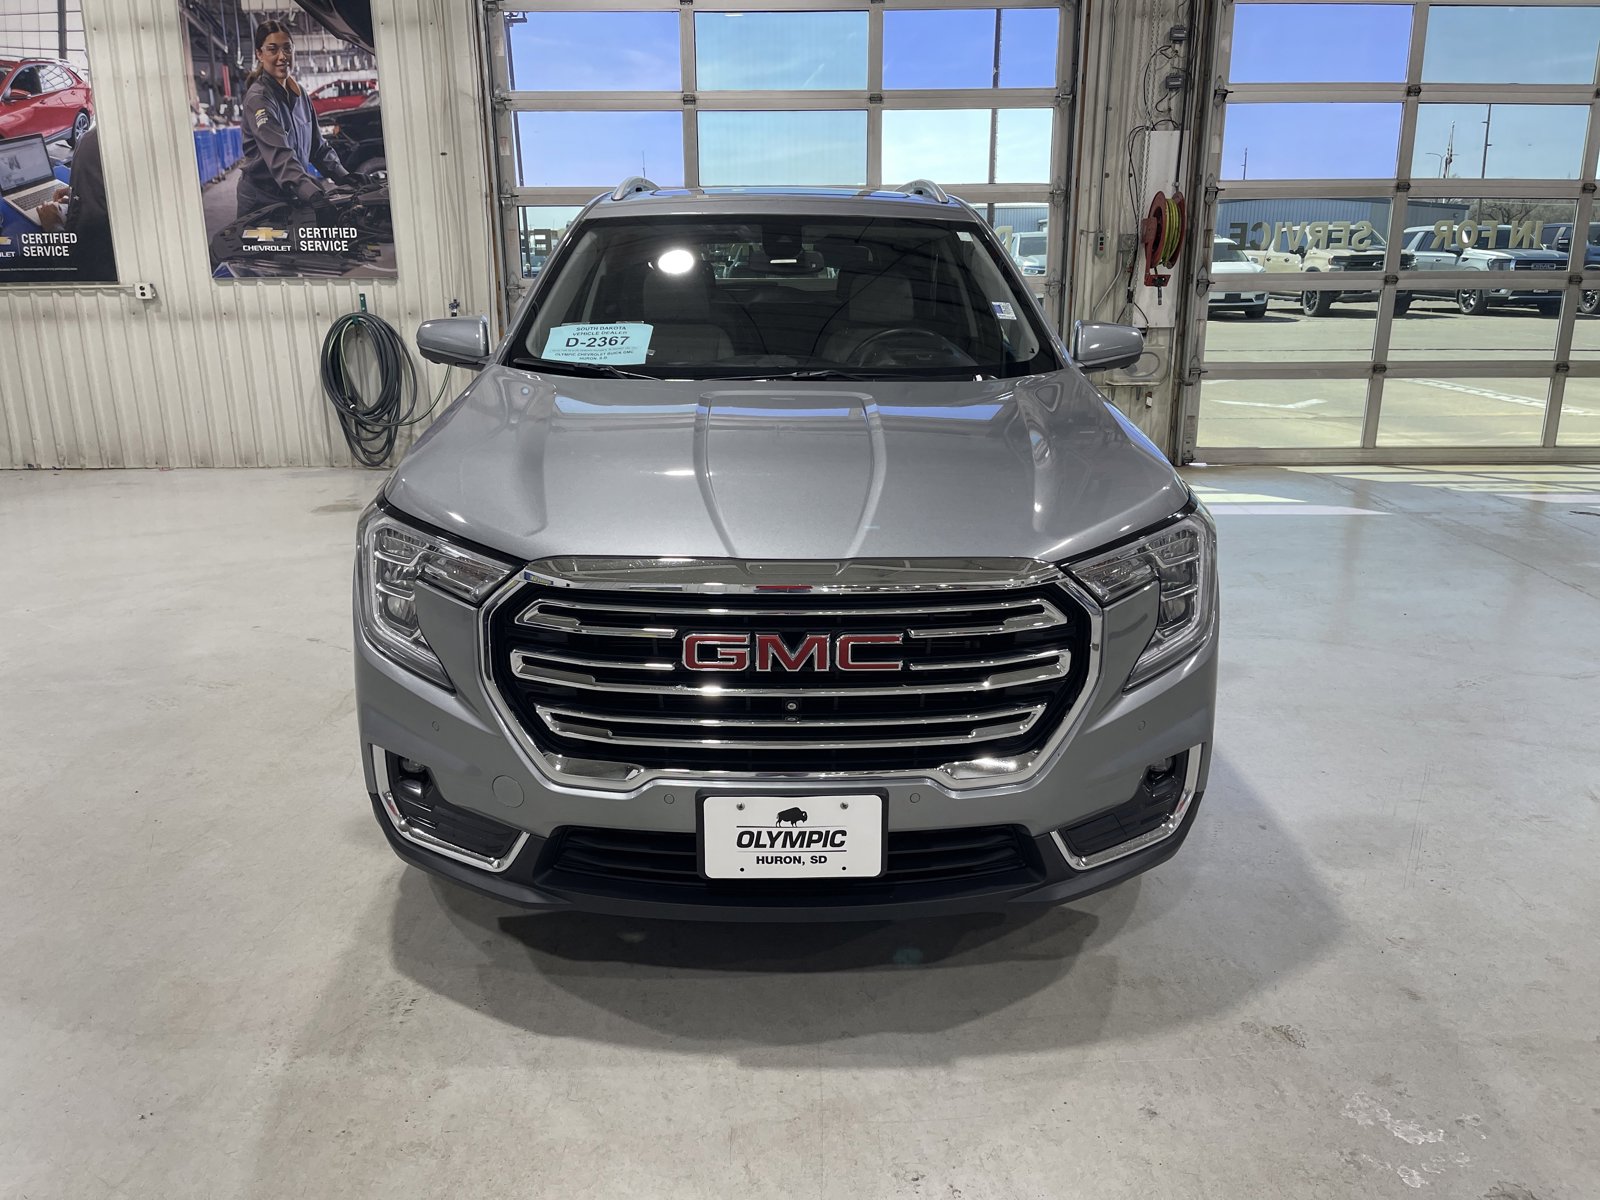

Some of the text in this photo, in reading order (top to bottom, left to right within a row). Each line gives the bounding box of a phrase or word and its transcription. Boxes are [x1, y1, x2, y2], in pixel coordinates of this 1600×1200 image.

[21, 232, 78, 244] CERTIFIED
[298, 227, 358, 239] CERTIFIED
[23, 245, 70, 257] SERVICE
[300, 240, 349, 252] SERVICE
[566, 336, 630, 347] D-2367
[682, 632, 904, 672] GMC
[736, 830, 847, 848] OLYMPIC
[756, 856, 828, 866] HURON, SD
